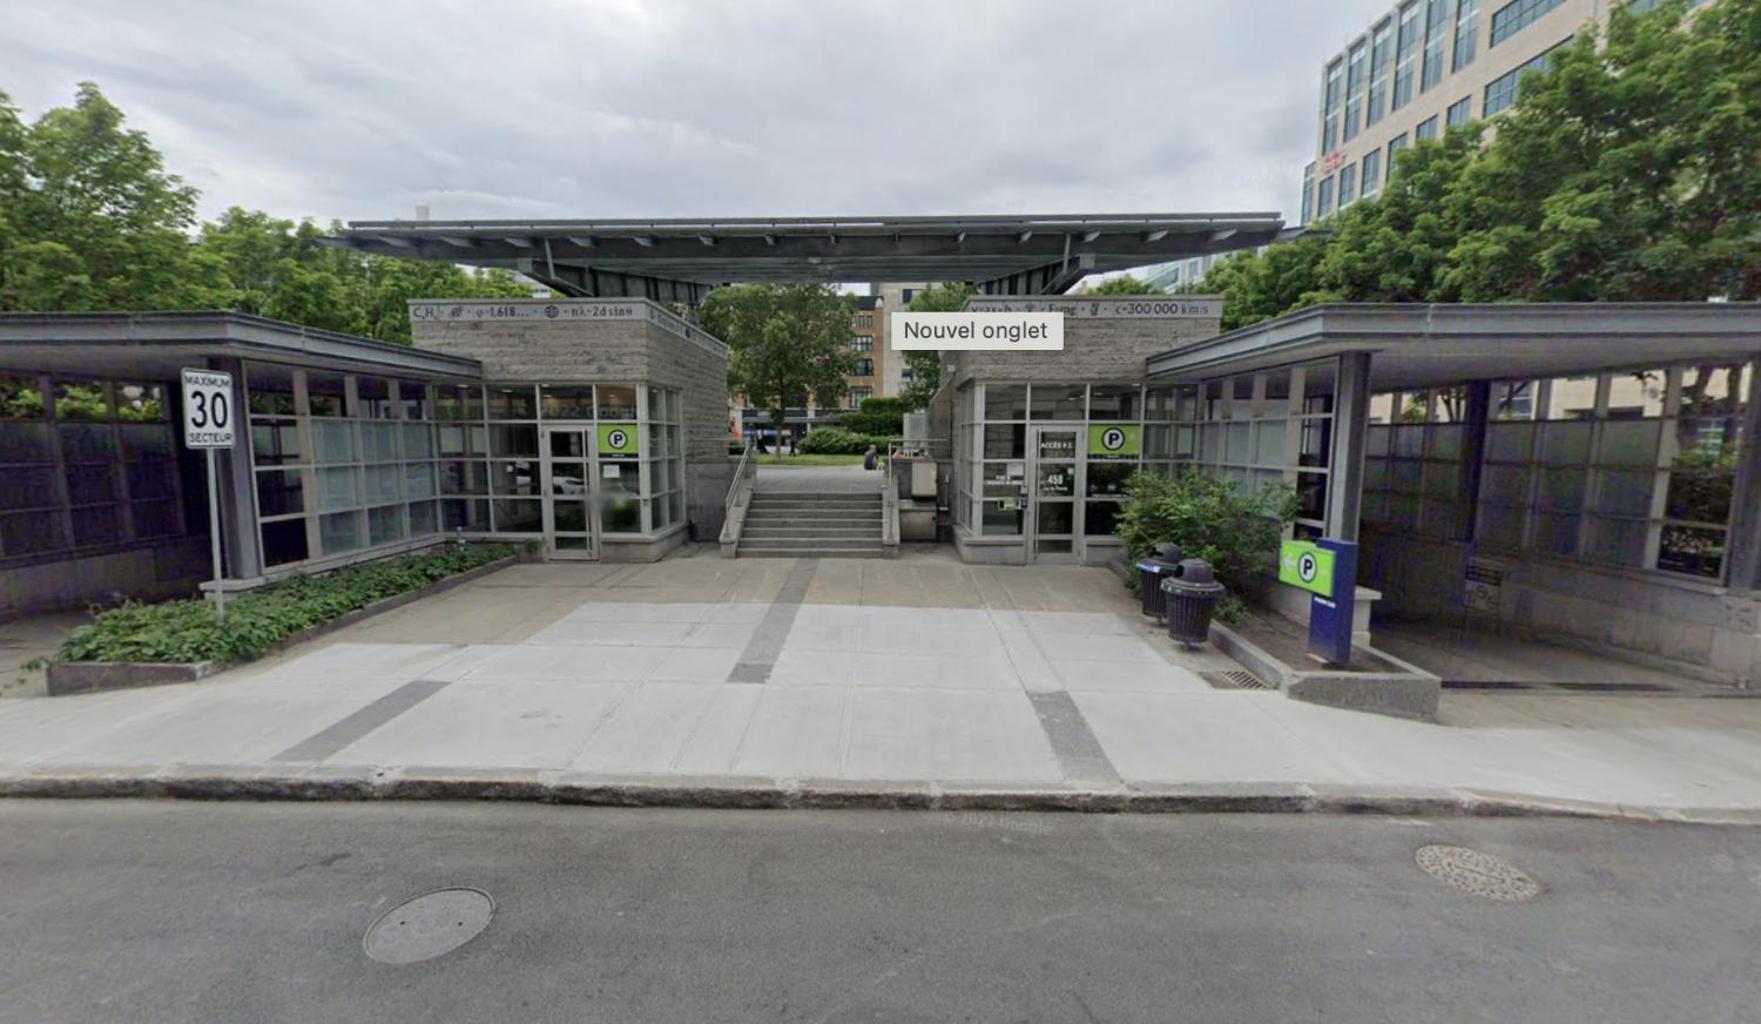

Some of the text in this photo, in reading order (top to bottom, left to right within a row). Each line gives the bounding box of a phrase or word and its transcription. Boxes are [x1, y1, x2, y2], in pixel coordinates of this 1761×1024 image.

[1153, 303, 1179, 315] 000
[184, 375, 230, 388] MAXIMUM
[191, 390, 229, 429] 30
[189, 432, 233, 443] SECTEUR
[613, 433, 623, 446] P
[1108, 432, 1120, 446] P
[1047, 474, 1063, 486] 450
[1303, 557, 1313, 576] P
